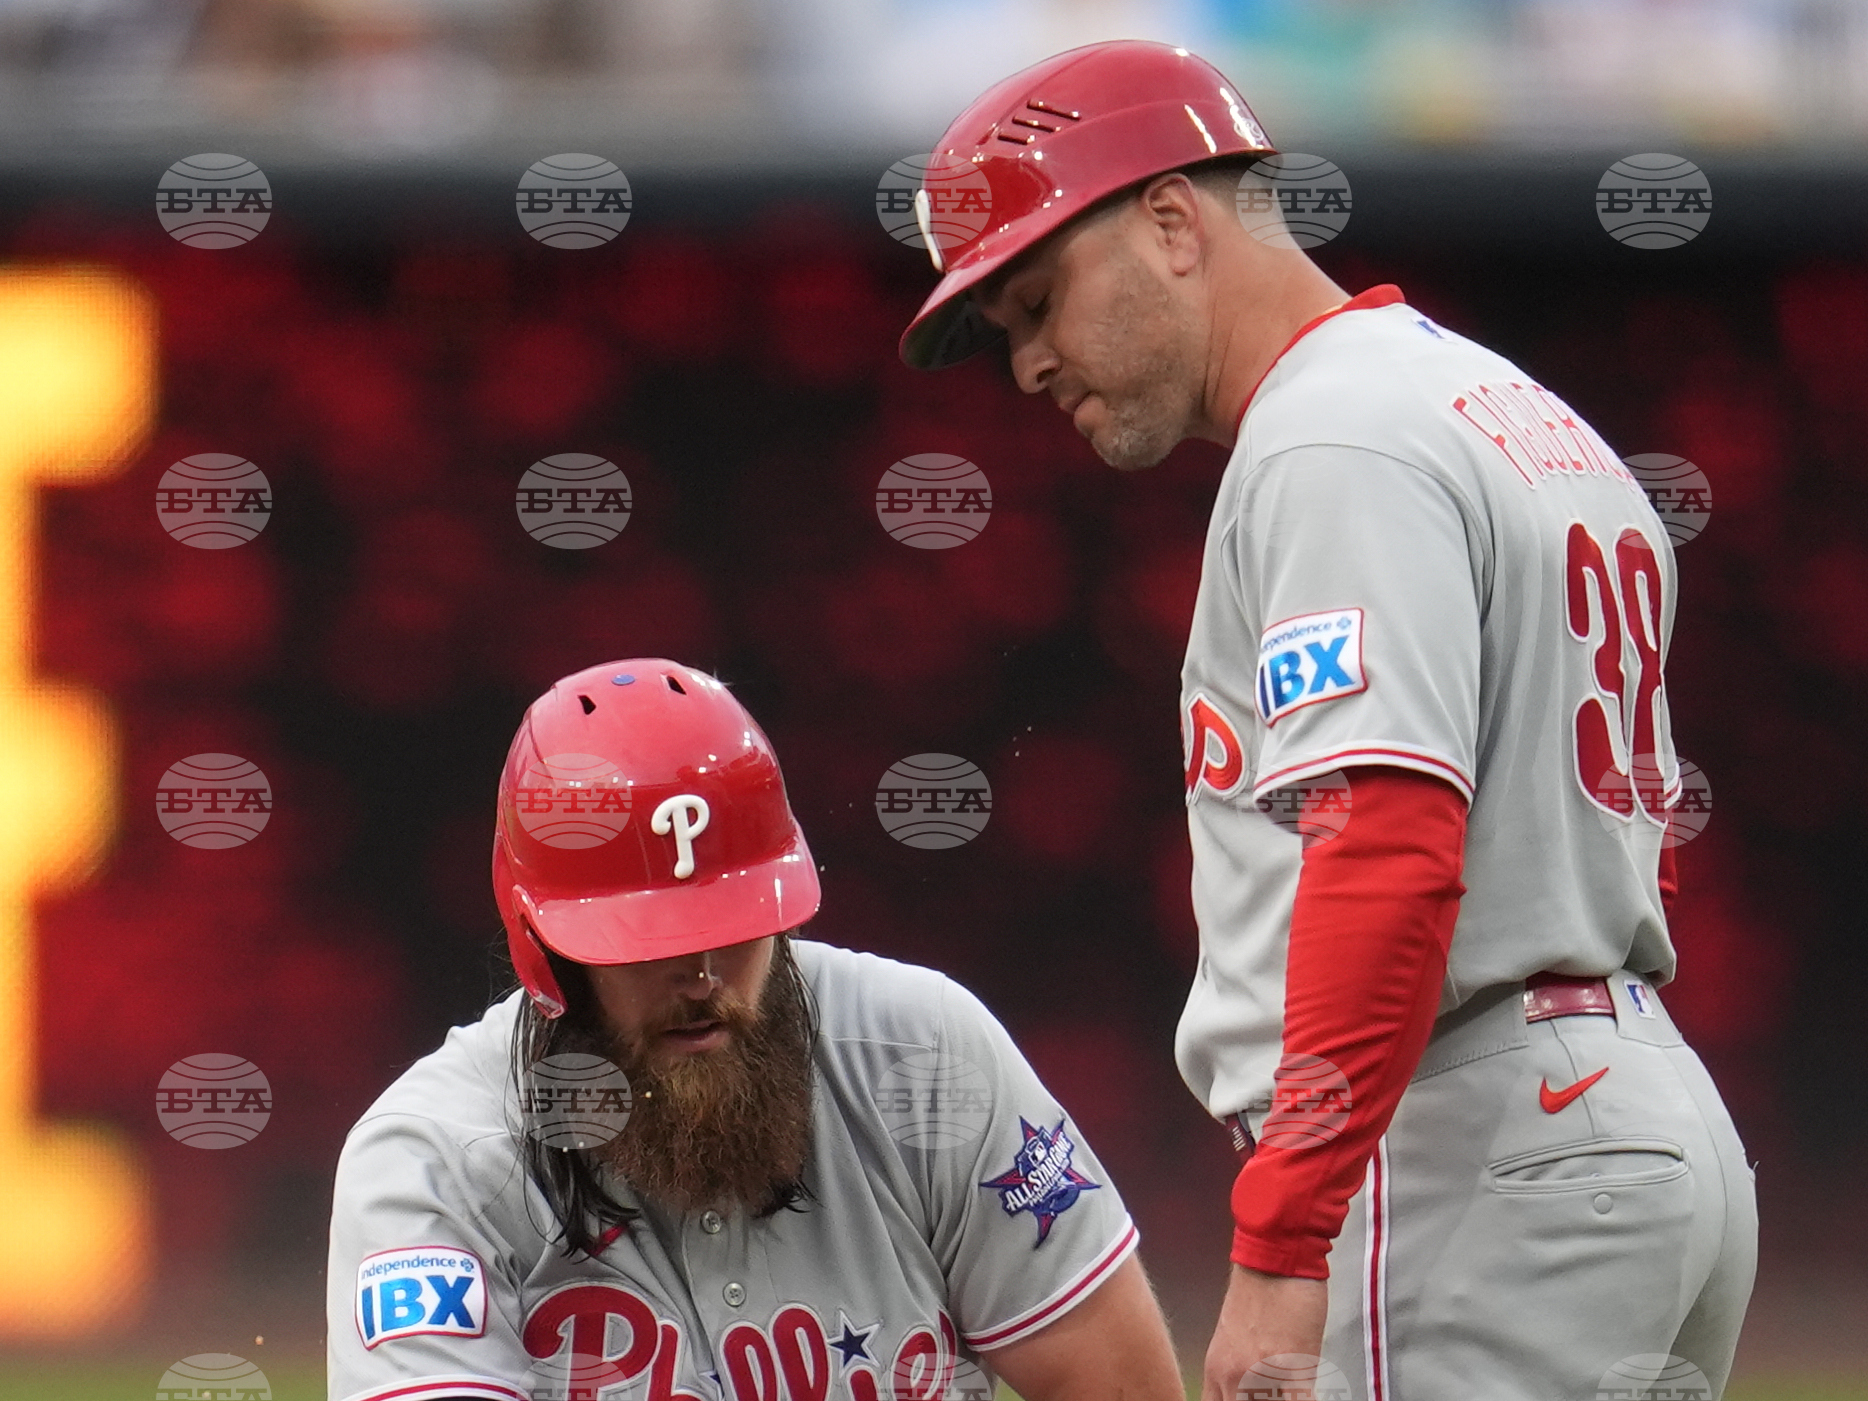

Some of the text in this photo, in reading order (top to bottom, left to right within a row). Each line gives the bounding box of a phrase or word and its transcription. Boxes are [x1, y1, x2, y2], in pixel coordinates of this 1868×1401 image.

[1453, 381, 1636, 491] FIGUER
[1260, 635, 1355, 719] IBX
[1564, 518, 1668, 824] 38
[651, 794, 710, 879] P
[362, 1275, 476, 1340] IBX
